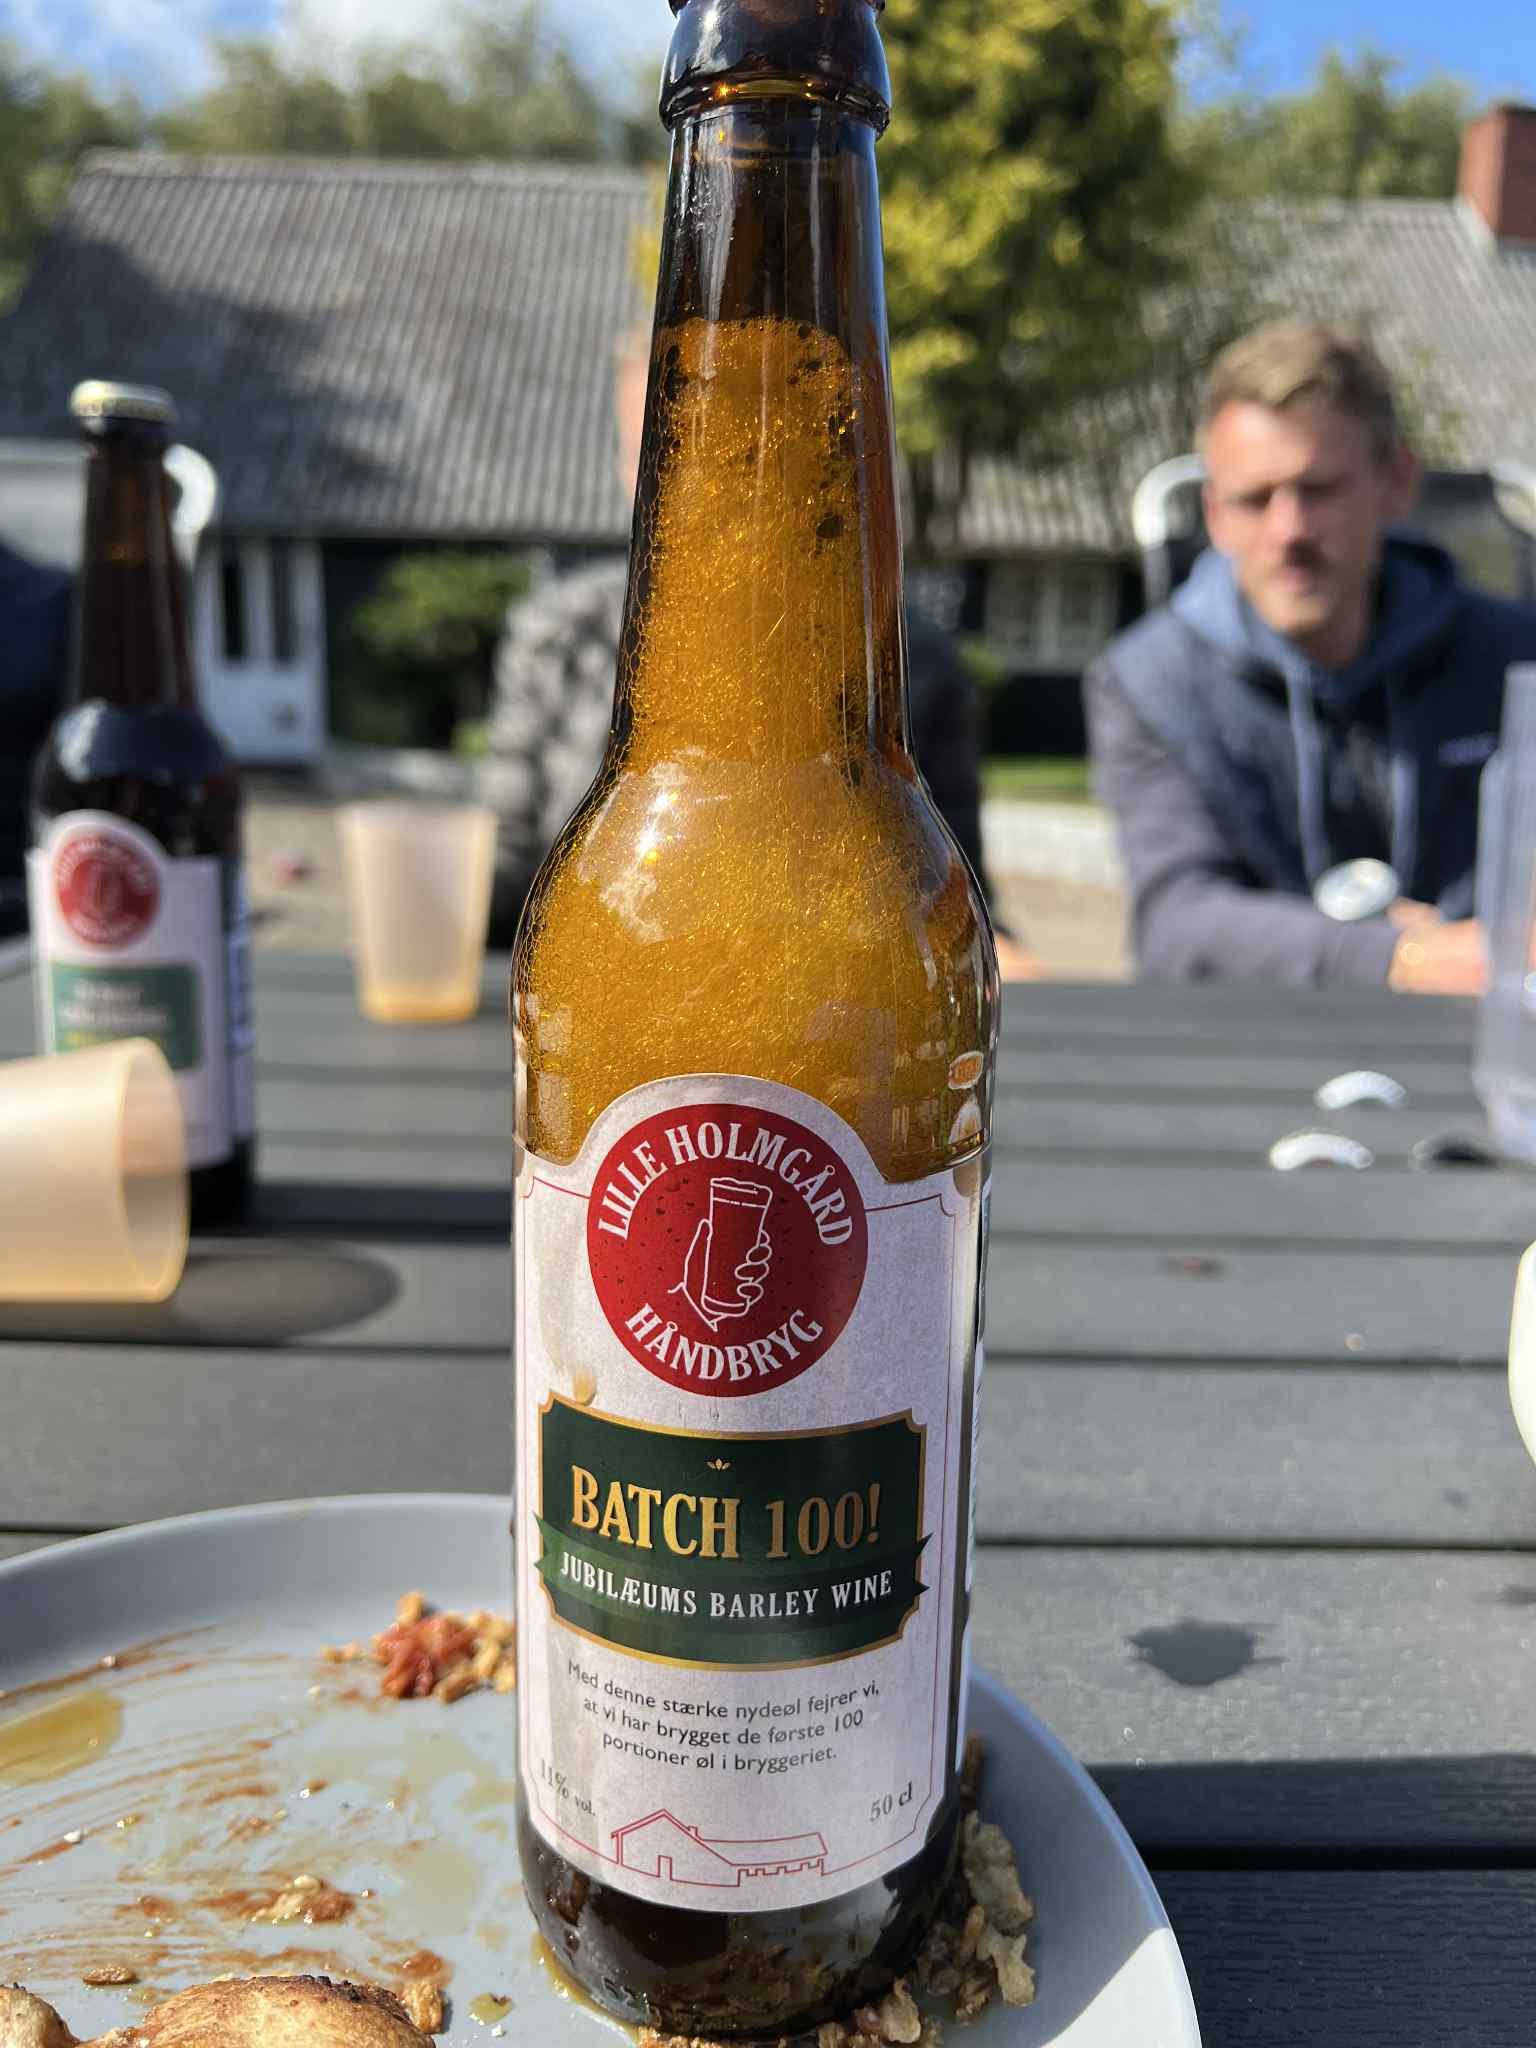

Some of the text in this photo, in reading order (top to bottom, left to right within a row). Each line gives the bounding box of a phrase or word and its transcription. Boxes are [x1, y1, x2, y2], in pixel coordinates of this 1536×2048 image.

[598, 1122, 853, 1245] LILLE HOLMGÅRD
[625, 1303, 824, 1382] HÅNDBRYG
[571, 1465, 881, 1558] BATCH 100!
[560, 1551, 892, 1619] JUBILÆUMS BARLEY WINE
[568, 1660, 598, 1688] Med
[604, 1680, 656, 1708] denne
[663, 1699, 728, 1718] stærke
[736, 1701, 800, 1723] nydeøl
[808, 1691, 856, 1714] fejrer
[584, 1698, 864, 1747] at vi har brygget de første 100
[603, 1733, 837, 1774] portioner øl i bryggeriet.
[541, 1760, 596, 1816] 11% vol.
[869, 1782, 913, 1822] 50 cl
